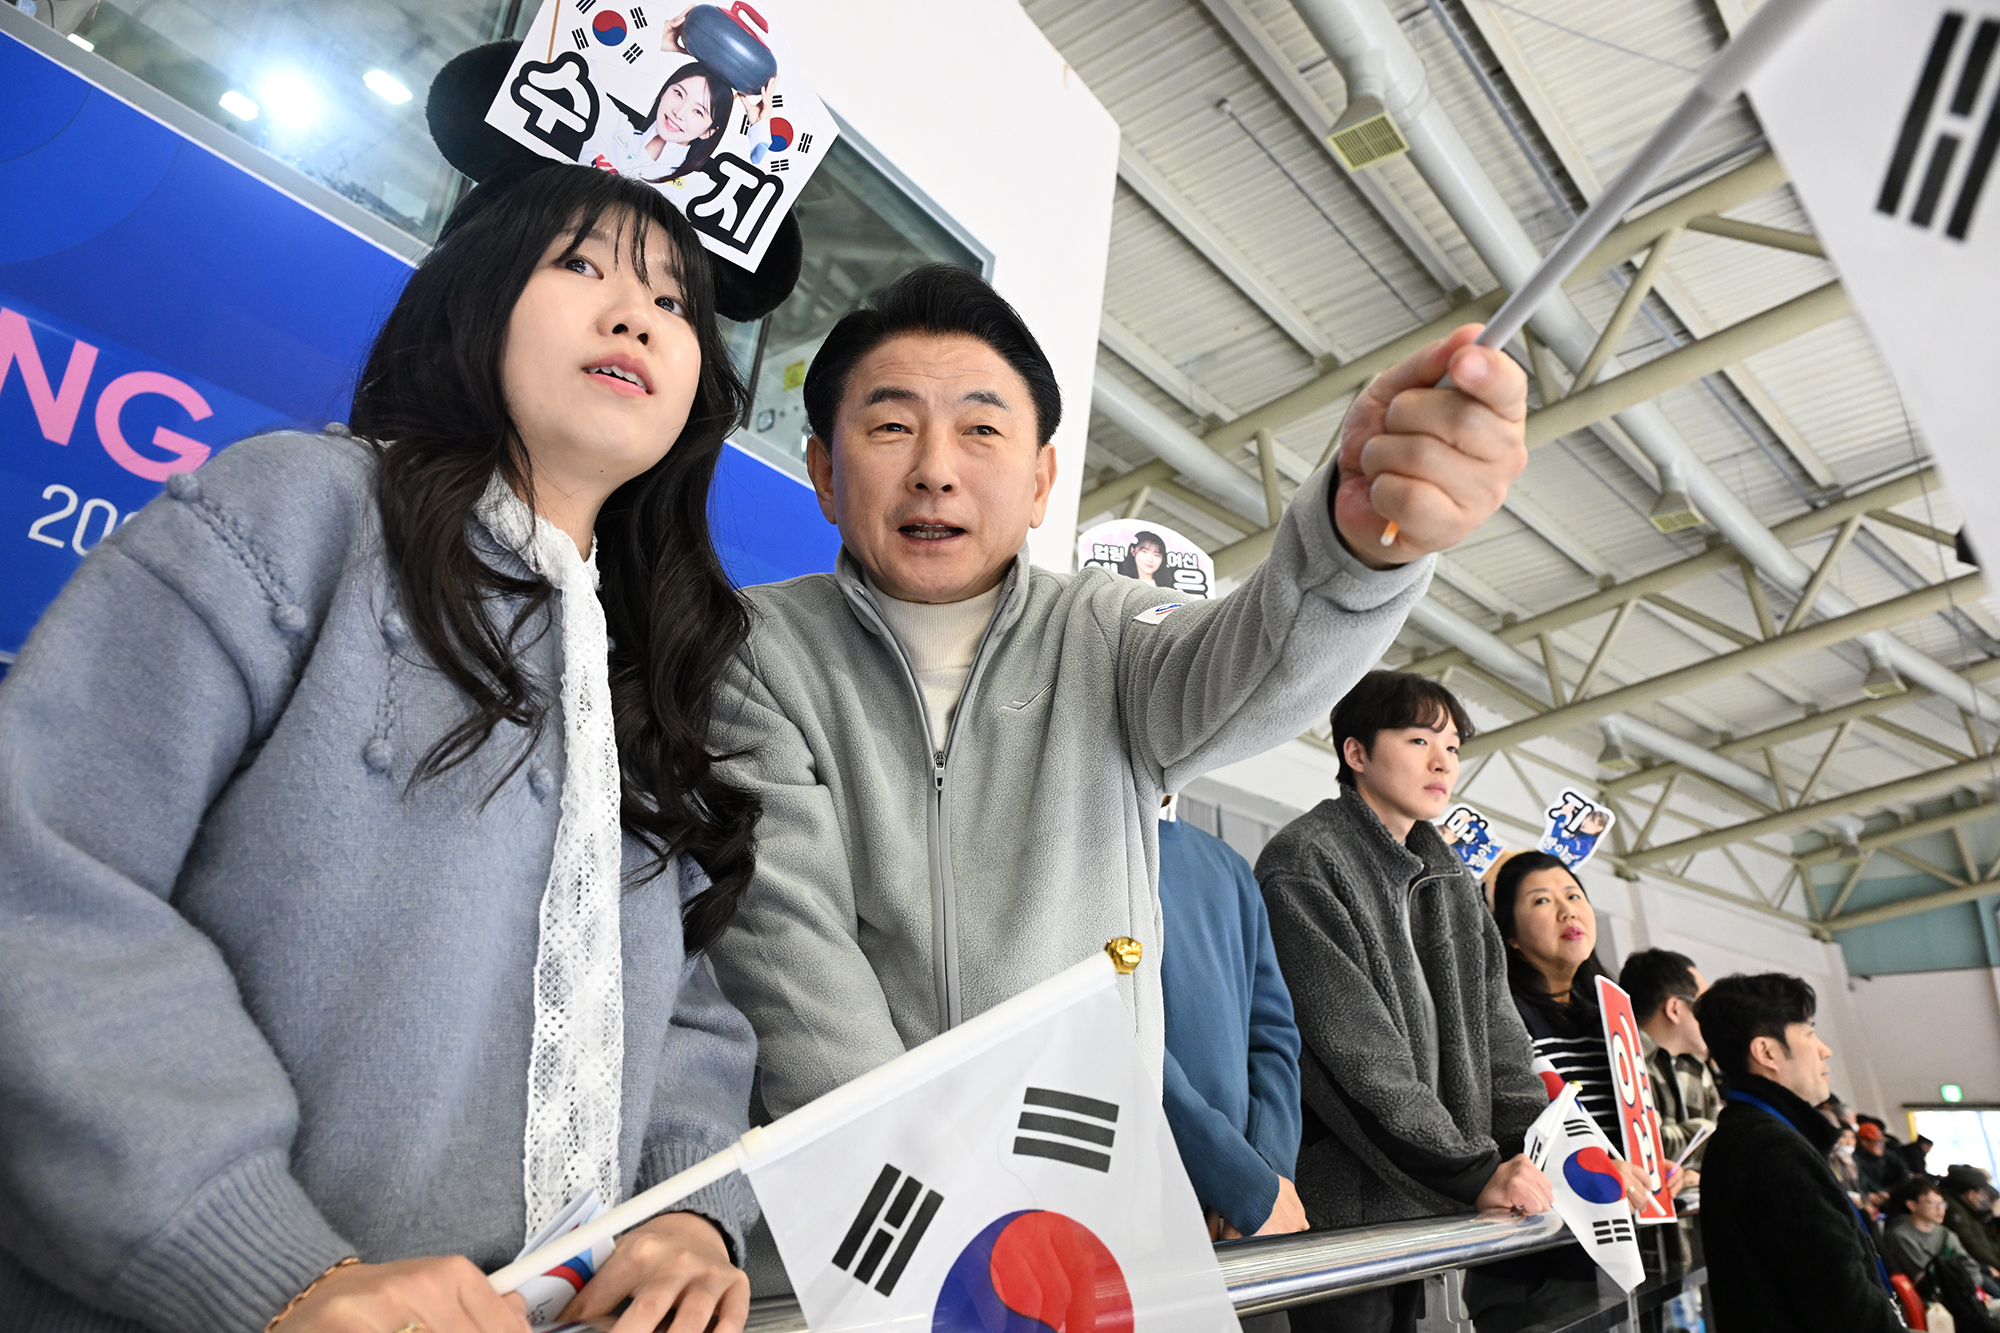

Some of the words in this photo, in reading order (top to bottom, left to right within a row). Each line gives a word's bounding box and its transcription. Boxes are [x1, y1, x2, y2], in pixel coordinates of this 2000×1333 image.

[512, 53, 598, 140] 수
[688, 154, 782, 252] 지
[0, 307, 213, 482] NG
[27, 484, 140, 557] 20
[1093, 544, 1127, 561] 컬링
[1167, 552, 1198, 569] 여신
